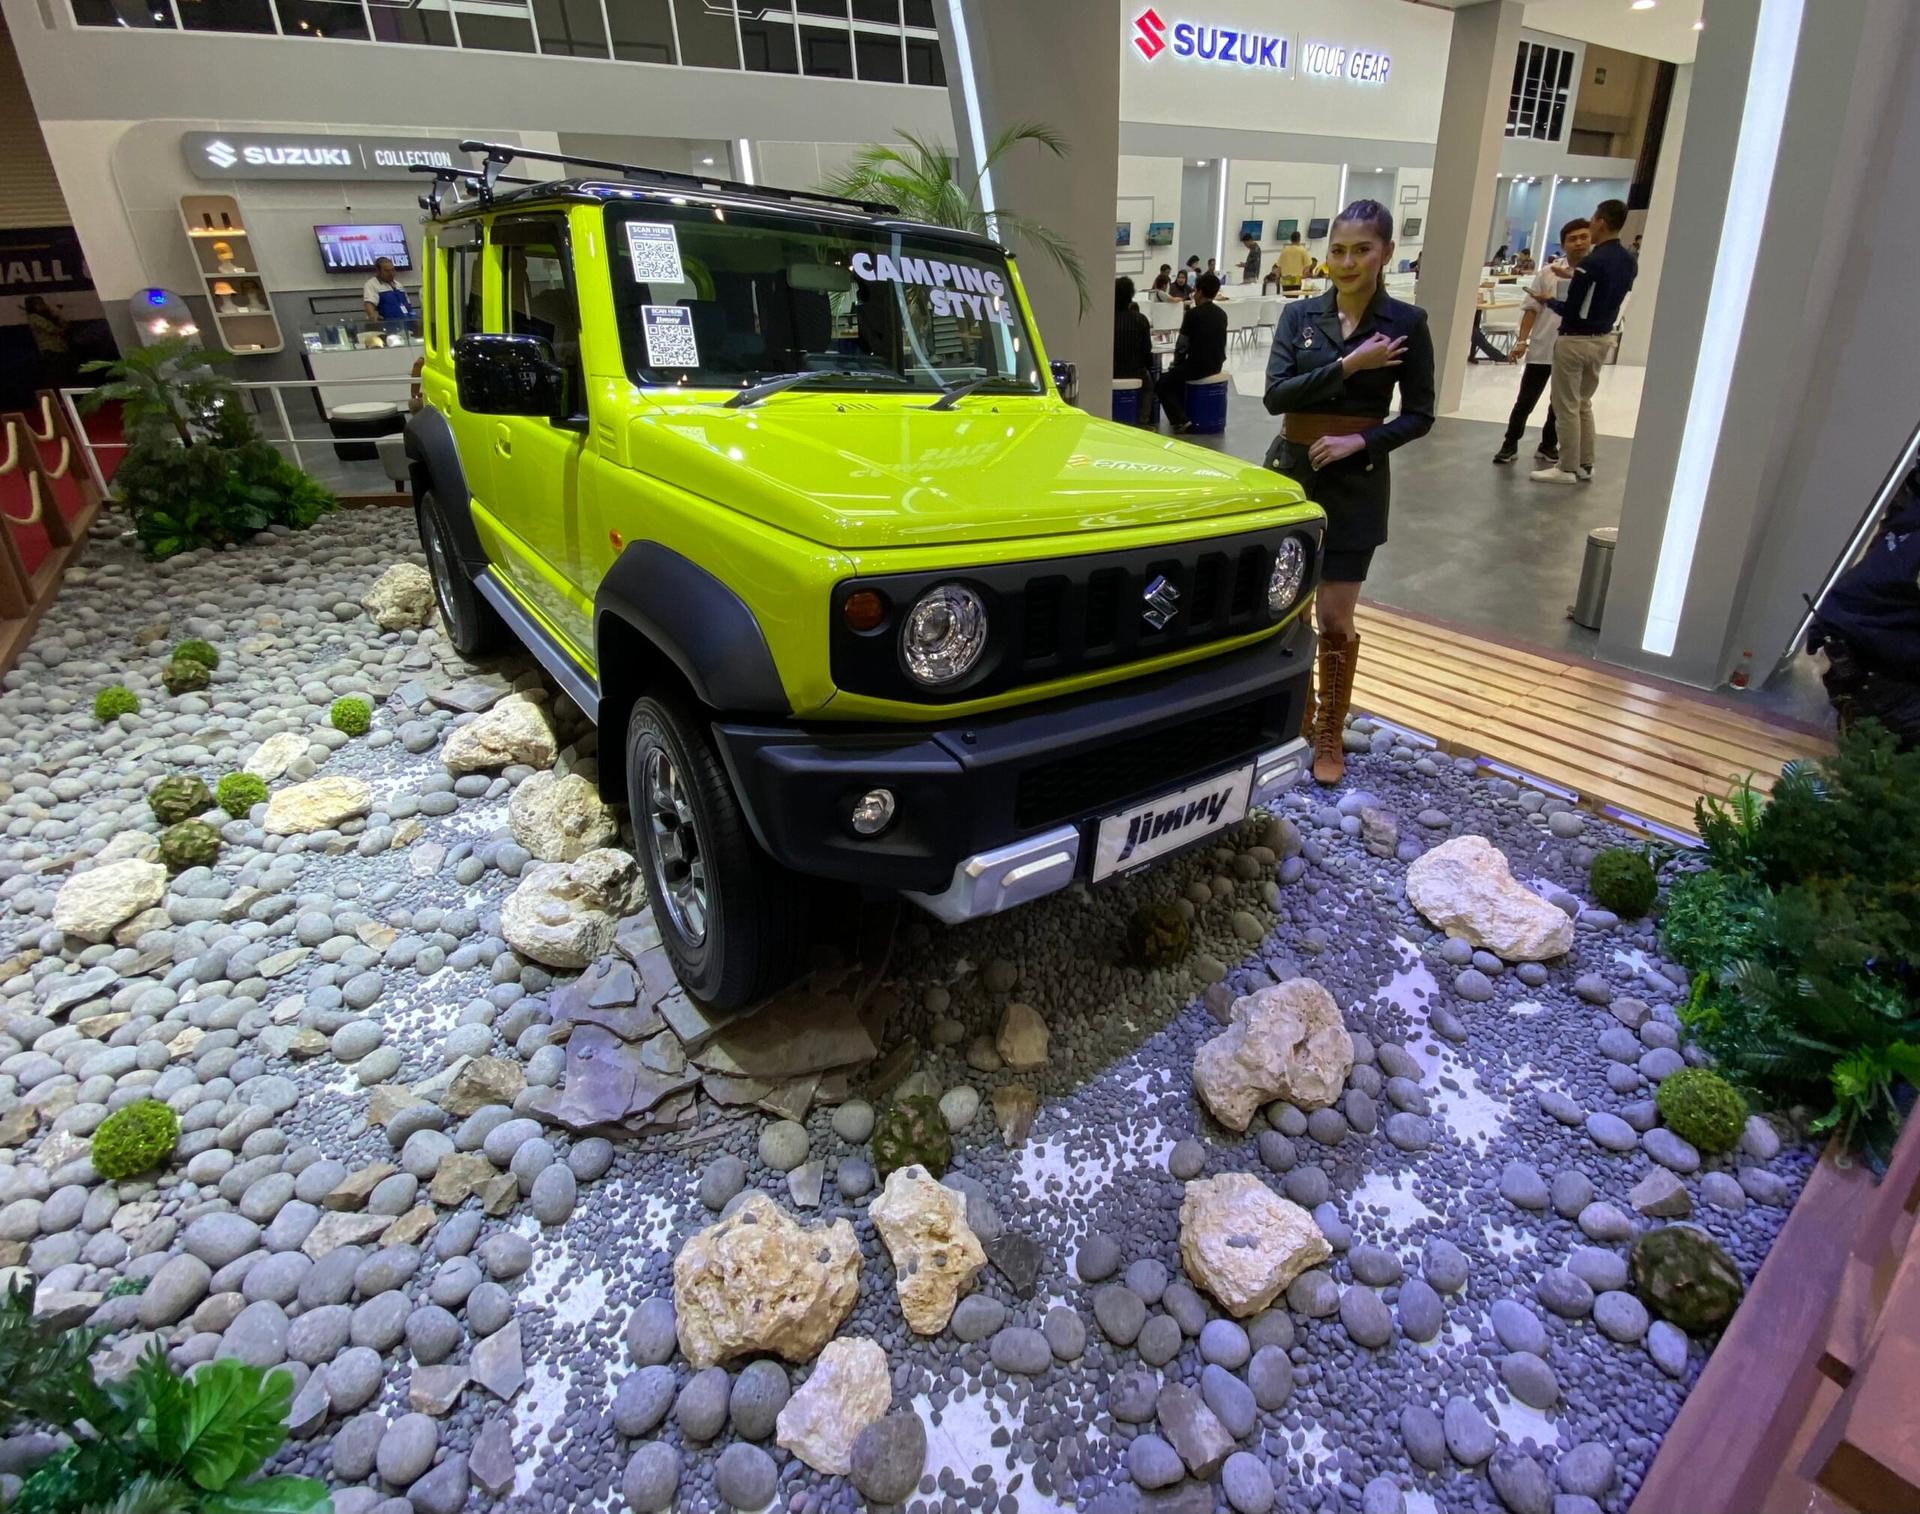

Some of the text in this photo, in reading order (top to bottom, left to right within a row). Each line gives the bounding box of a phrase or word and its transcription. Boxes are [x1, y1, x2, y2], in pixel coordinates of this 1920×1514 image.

[1173, 22, 1391, 83] SUZUKI YOUR GEAR
[242, 146, 452, 168] SUZUKI COLLECTION
[338, 243, 374, 267] JUTA
[852, 252, 1004, 297] CAMPING
[929, 289, 1015, 327] STYLE
[1117, 787, 1233, 863] Jimny
